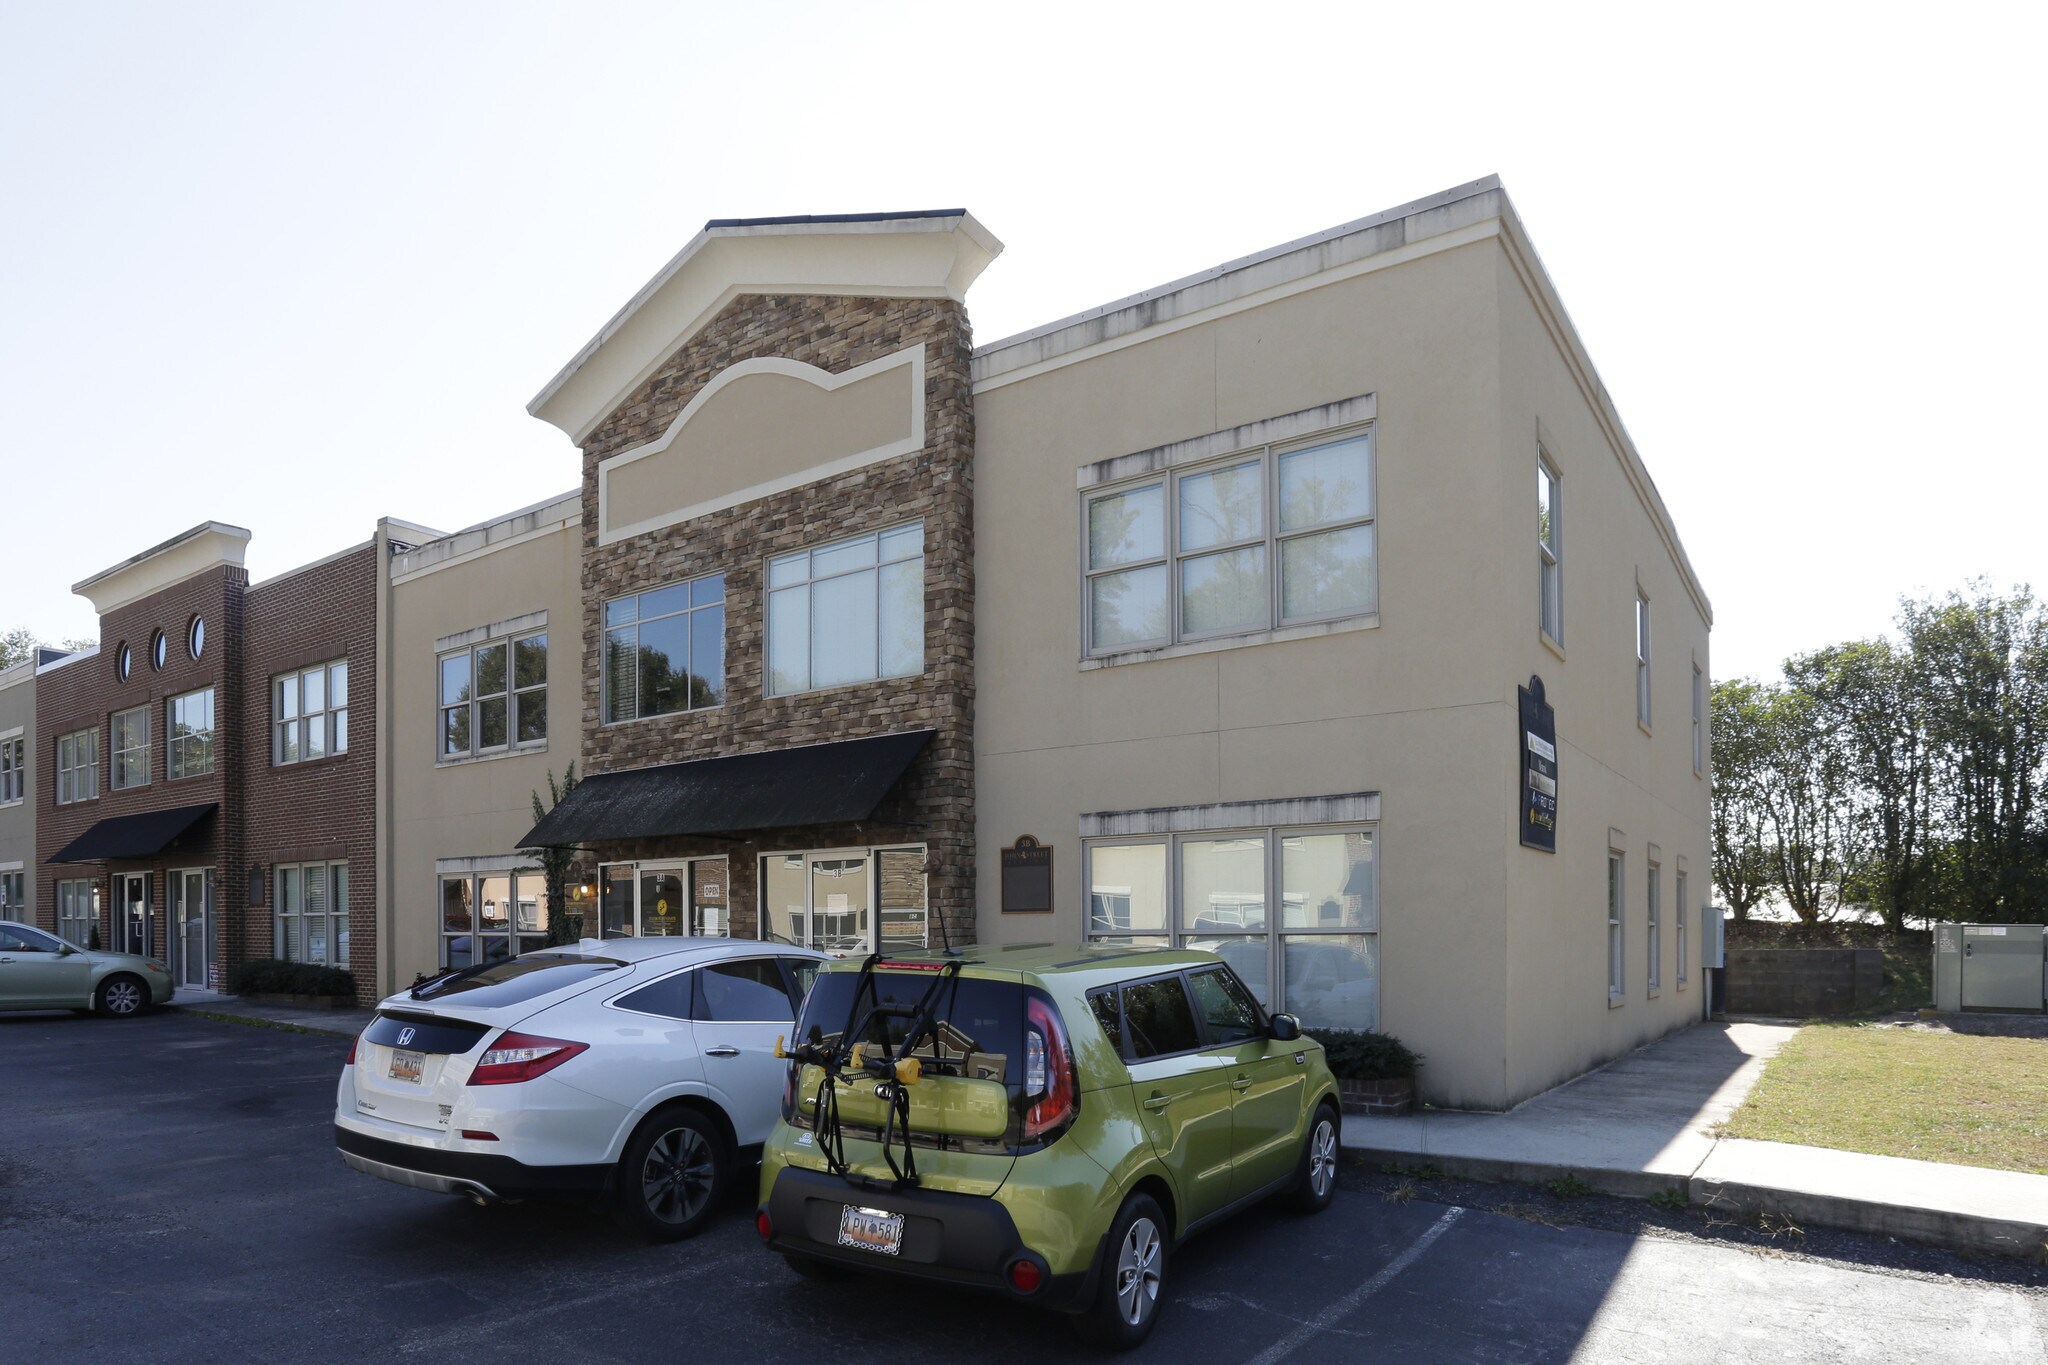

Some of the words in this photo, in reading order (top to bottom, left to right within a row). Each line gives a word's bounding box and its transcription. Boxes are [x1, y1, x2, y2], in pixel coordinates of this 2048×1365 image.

[833, 869, 842, 878] 3B
[705, 886, 719, 896] OPEN
[877, 1222, 897, 1242] 581
